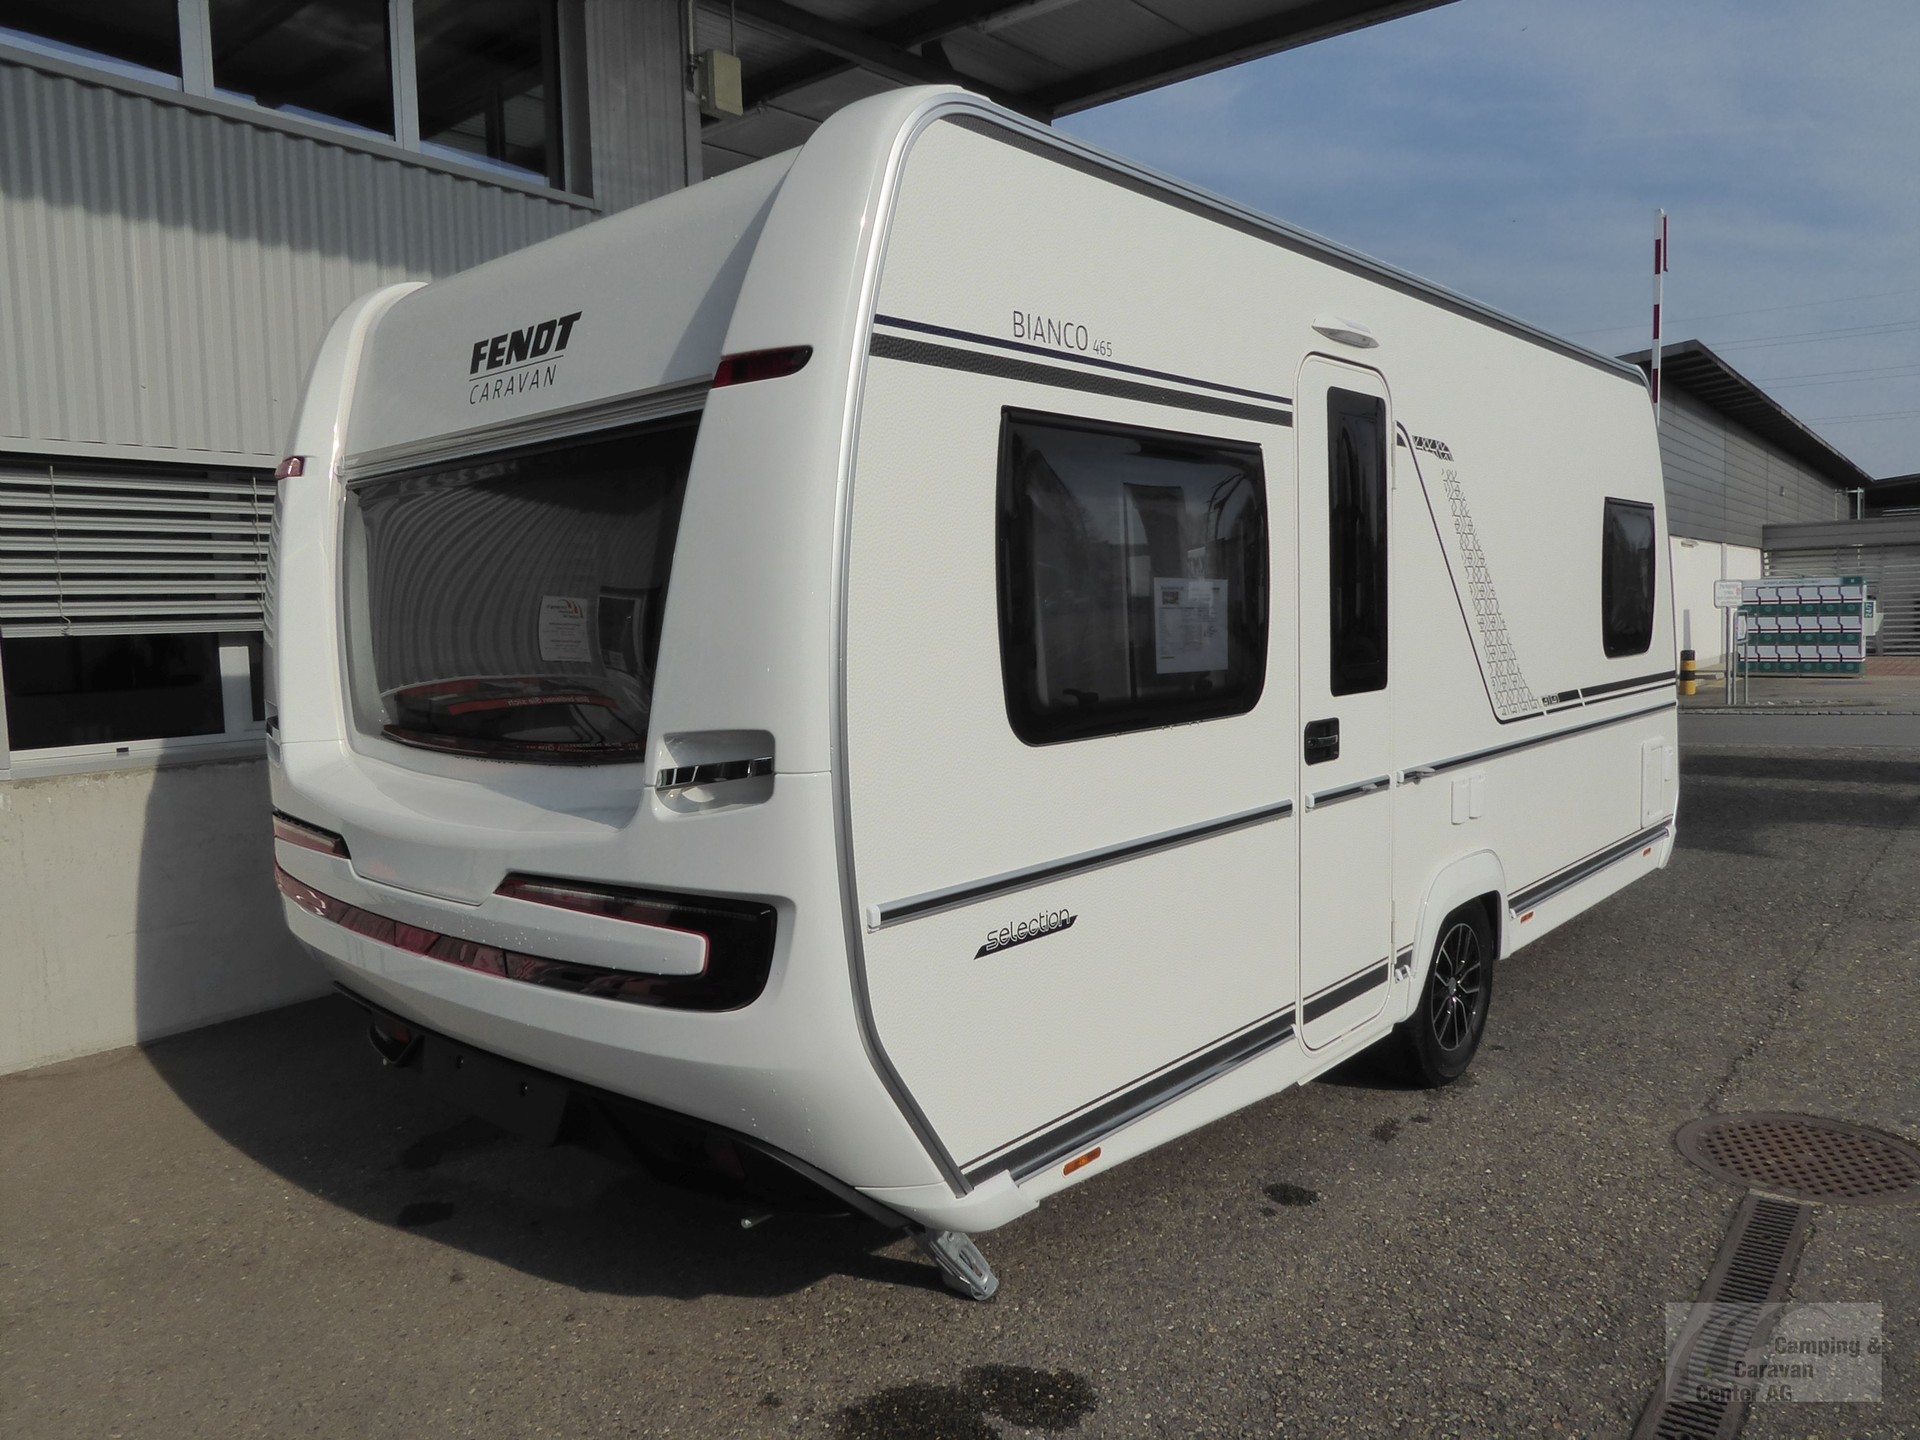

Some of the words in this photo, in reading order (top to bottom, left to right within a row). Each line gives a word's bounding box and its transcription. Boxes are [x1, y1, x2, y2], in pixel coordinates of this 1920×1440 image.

[470, 310, 583, 375] FENDT
[1013, 310, 1088, 351] BIANCO
[1093, 339, 1113, 357] 465
[469, 364, 556, 405] CARAVAN
[985, 908, 1070, 951] selection
